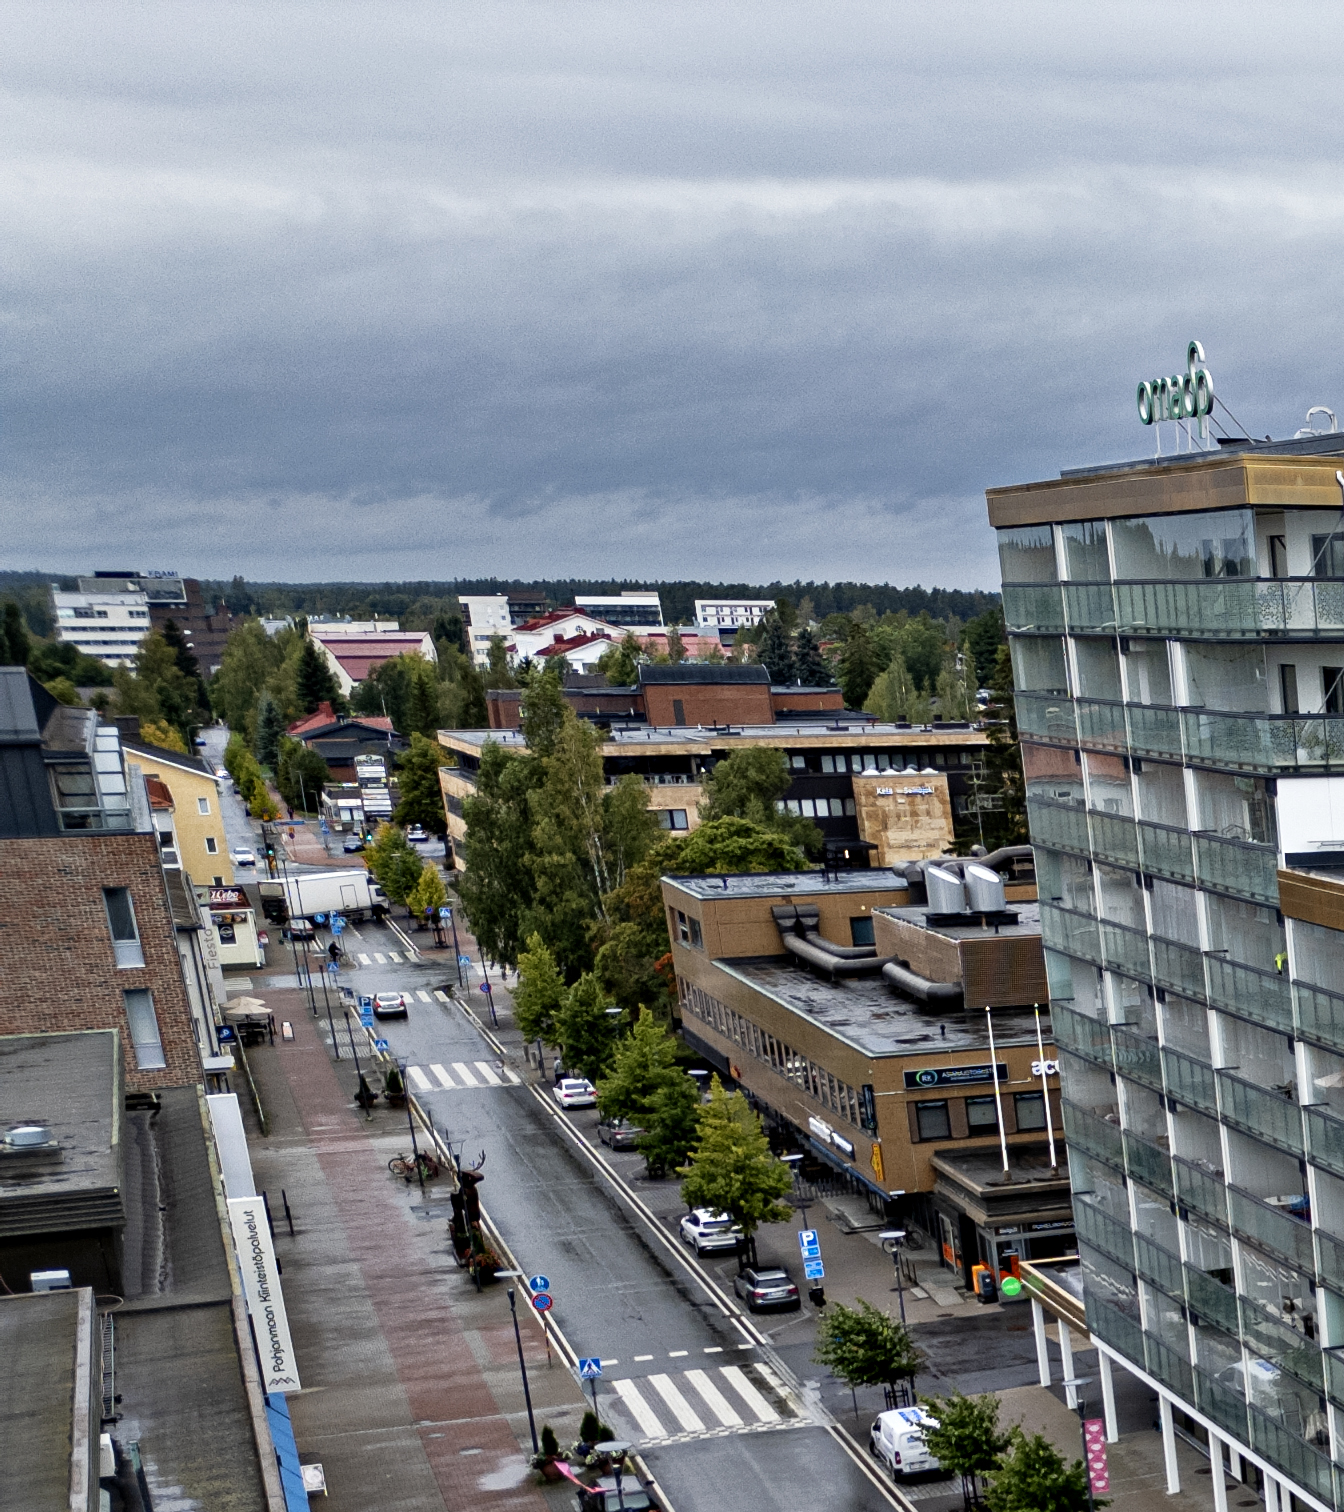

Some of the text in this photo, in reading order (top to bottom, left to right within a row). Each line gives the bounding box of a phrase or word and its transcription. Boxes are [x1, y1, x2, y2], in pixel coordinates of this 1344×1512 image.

[802, 1231, 814, 1247] P
[243, 1209, 286, 1373] Pohjanmaan Kiinteistöpalvelut
